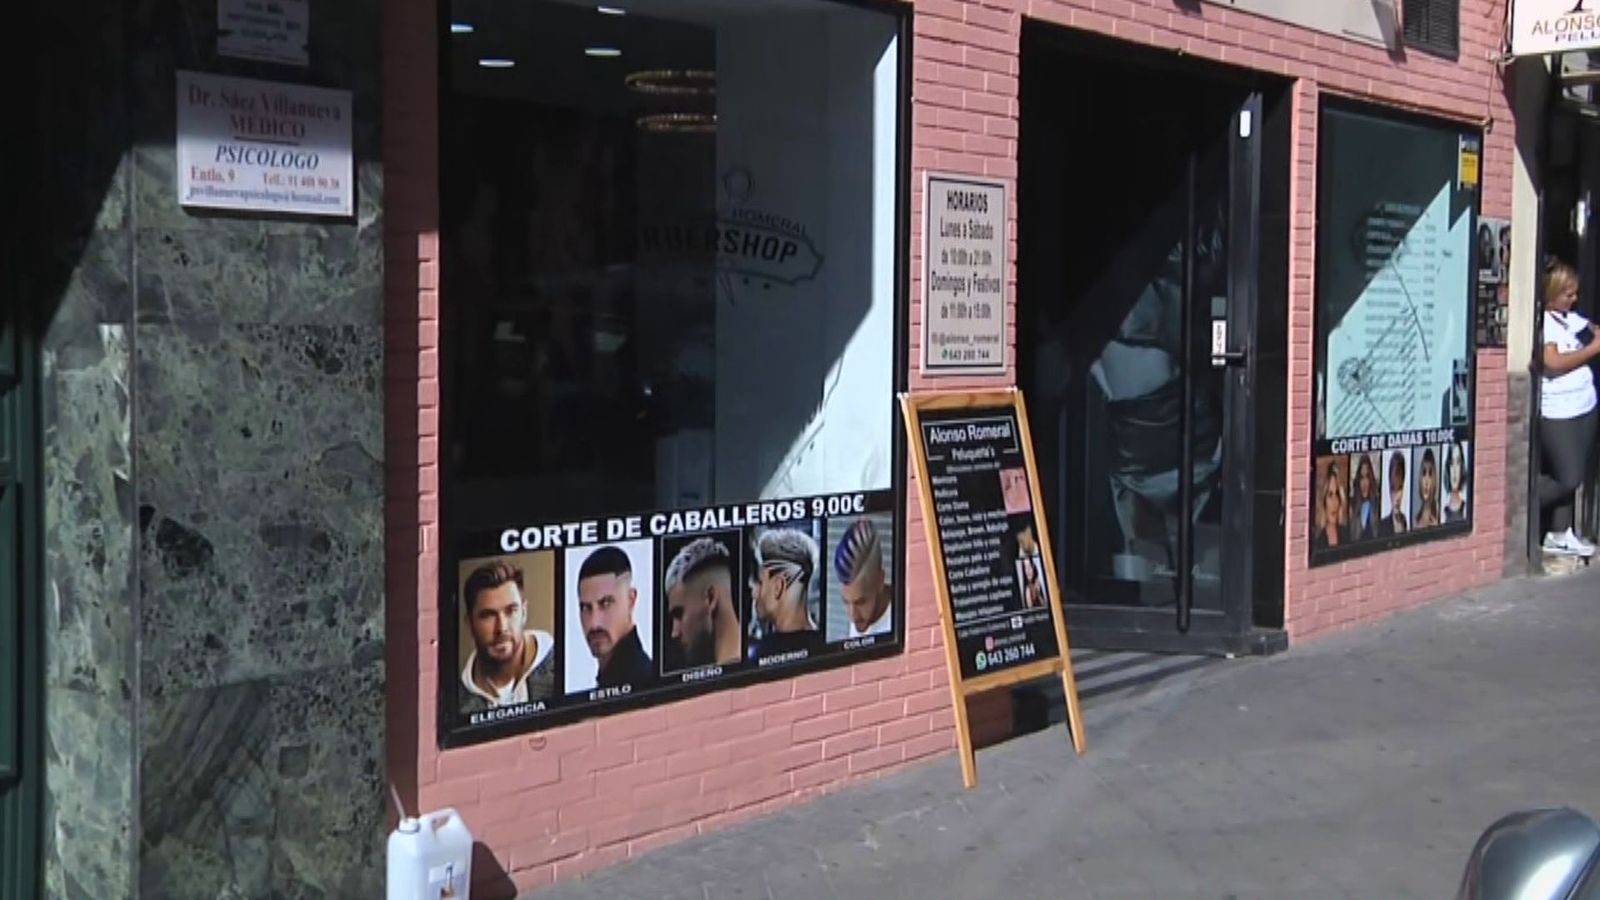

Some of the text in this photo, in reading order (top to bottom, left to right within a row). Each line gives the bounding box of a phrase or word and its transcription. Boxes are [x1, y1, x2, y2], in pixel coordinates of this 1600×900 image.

[1531, 14, 1600, 35] ALONS
[188, 84, 214, 106] Dr.
[260, 92, 341, 121] Villanueva
[228, 169, 235, 182] 9
[947, 190, 989, 214] HORARIOS
[940, 217, 961, 238] Lunes
[963, 224, 967, 238] a
[941, 250, 949, 266] de
[969, 253, 973, 266] a
[931, 271, 1001, 298] Domingos y Festivos
[941, 303, 949, 319] de
[968, 306, 972, 319] a
[949, 348, 961, 361] 643
[978, 348, 990, 360] 744
[930, 422, 1011, 445] Alonso Romeral
[1331, 438, 1369, 454] CORTE
[1371, 435, 1385, 449] DE
[1388, 431, 1423, 447] DAMAS
[500, 494, 865, 552] CORTE DE CABALLEROS 9,00€
[843, 636, 876, 650] COLOR
[758, 649, 809, 667] MODERNO
[987, 643, 1035, 666] 643 260 744
[589, 684, 632, 701] ESTILO
[469, 701, 546, 725] ELEGANCIA
